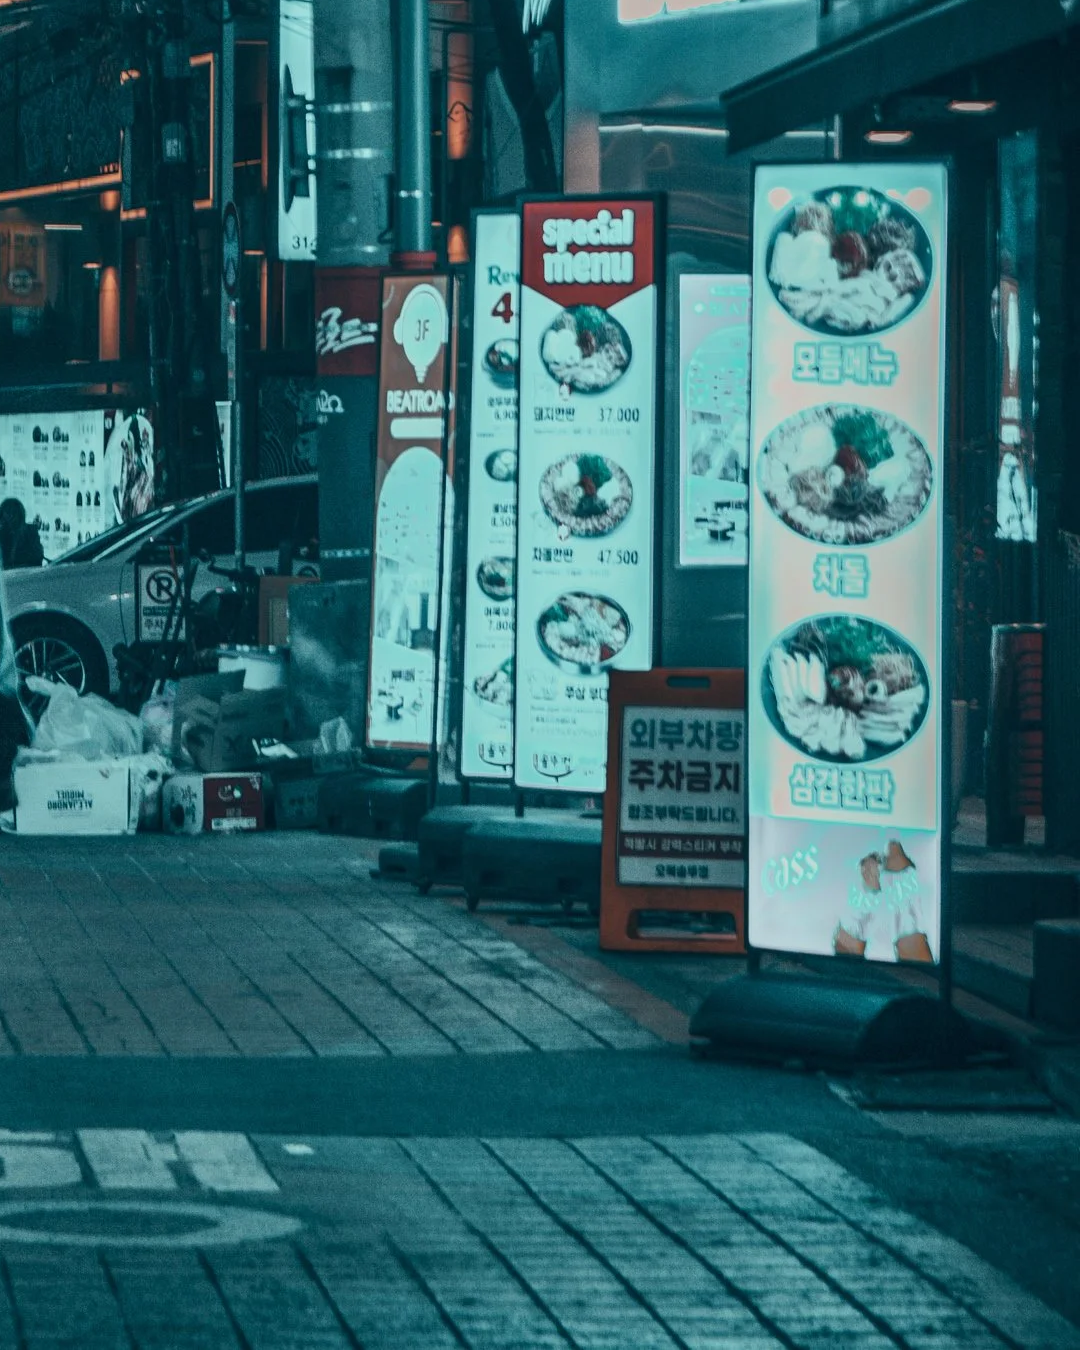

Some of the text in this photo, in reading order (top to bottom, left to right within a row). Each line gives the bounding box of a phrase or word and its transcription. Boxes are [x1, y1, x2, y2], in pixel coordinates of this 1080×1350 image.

[542, 209, 635, 254] special
[542, 250, 635, 285] menu
[628, 718, 743, 753] 외부차량
[627, 759, 741, 795] 주차금지
